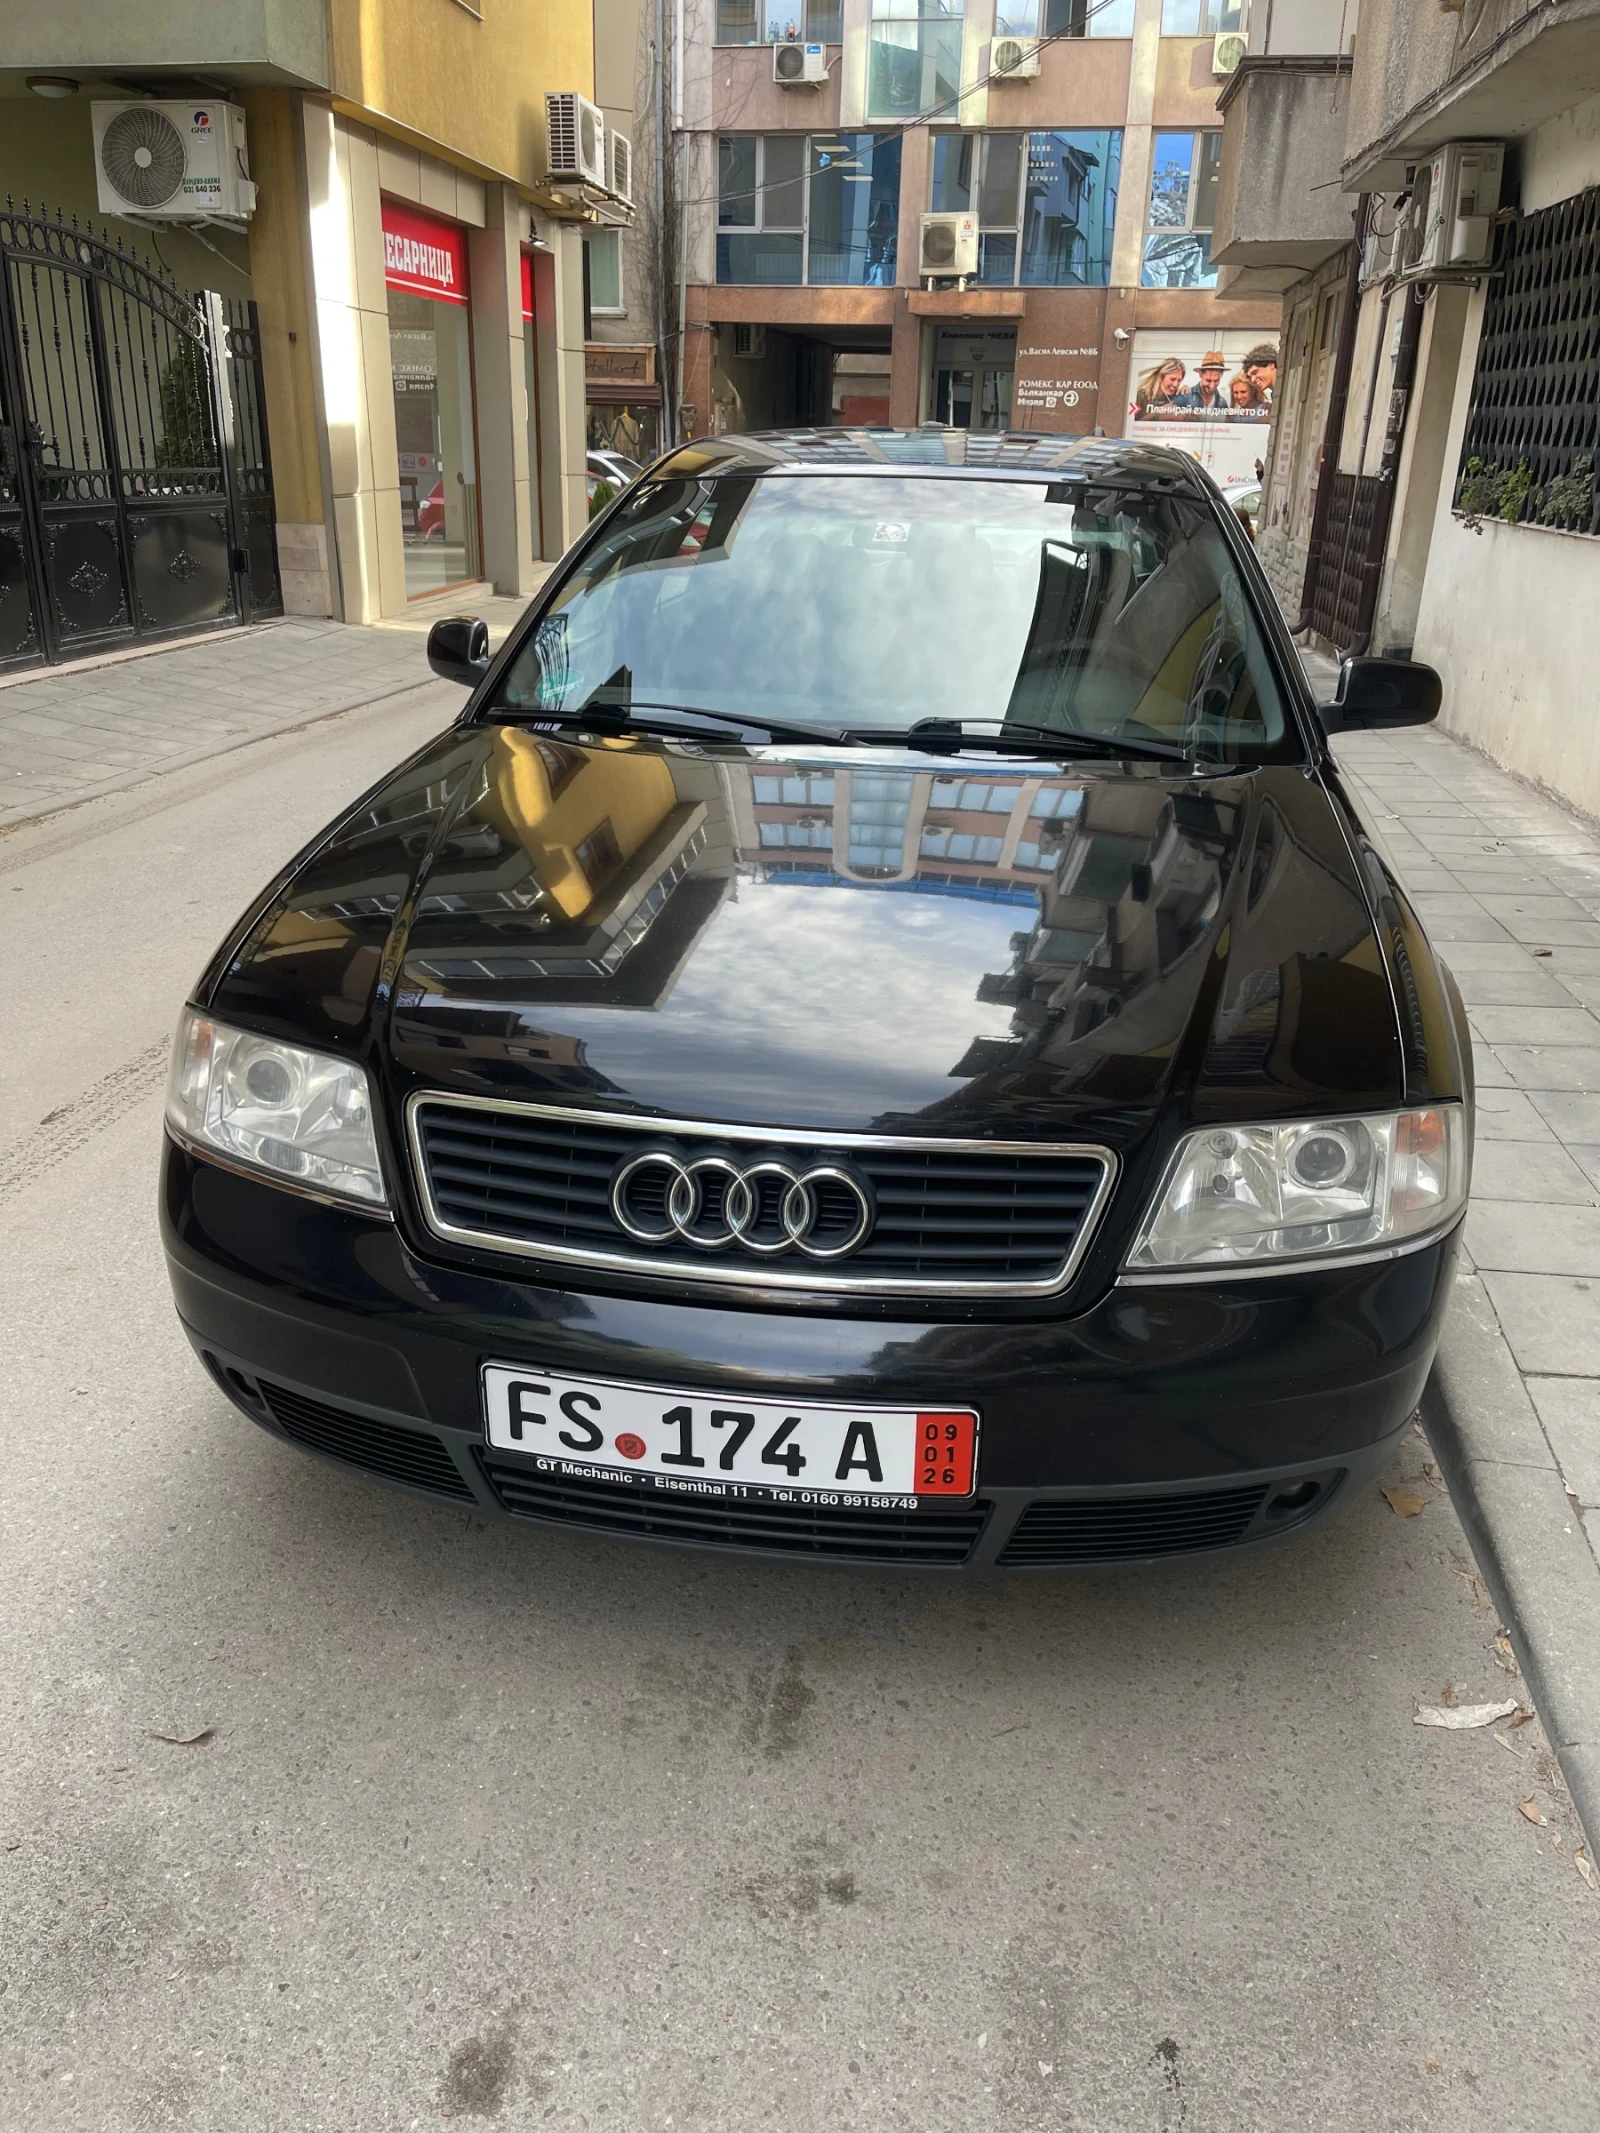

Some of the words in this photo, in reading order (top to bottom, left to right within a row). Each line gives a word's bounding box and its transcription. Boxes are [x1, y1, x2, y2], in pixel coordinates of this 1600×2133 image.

[195, 185, 207, 193] 640
[384, 232, 454, 287] ЕСАРНИЦА
[1018, 380, 1054, 388] РОМЕКС
[1073, 381, 1099, 390] ЕООД
[1146, 404, 1191, 416] Планирай
[1193, 406, 1255, 417] ежедневието
[508, 1381, 604, 1452] FS
[661, 1406, 807, 1477] 174
[835, 1421, 884, 1482] A
[925, 1424, 958, 1441] 09
[924, 1446, 955, 1463] 01
[536, 1458, 557, 1471] GT
[561, 1463, 633, 1483] Mechanic
[654, 1476, 726, 1495] Eisenthal
[731, 1486, 748, 1498] 11
[770, 1489, 797, 1502] Tel.
[801, 1492, 838, 1505] 0160
[843, 1495, 918, 1509] 99158749
[923, 1468, 956, 1484] 26
